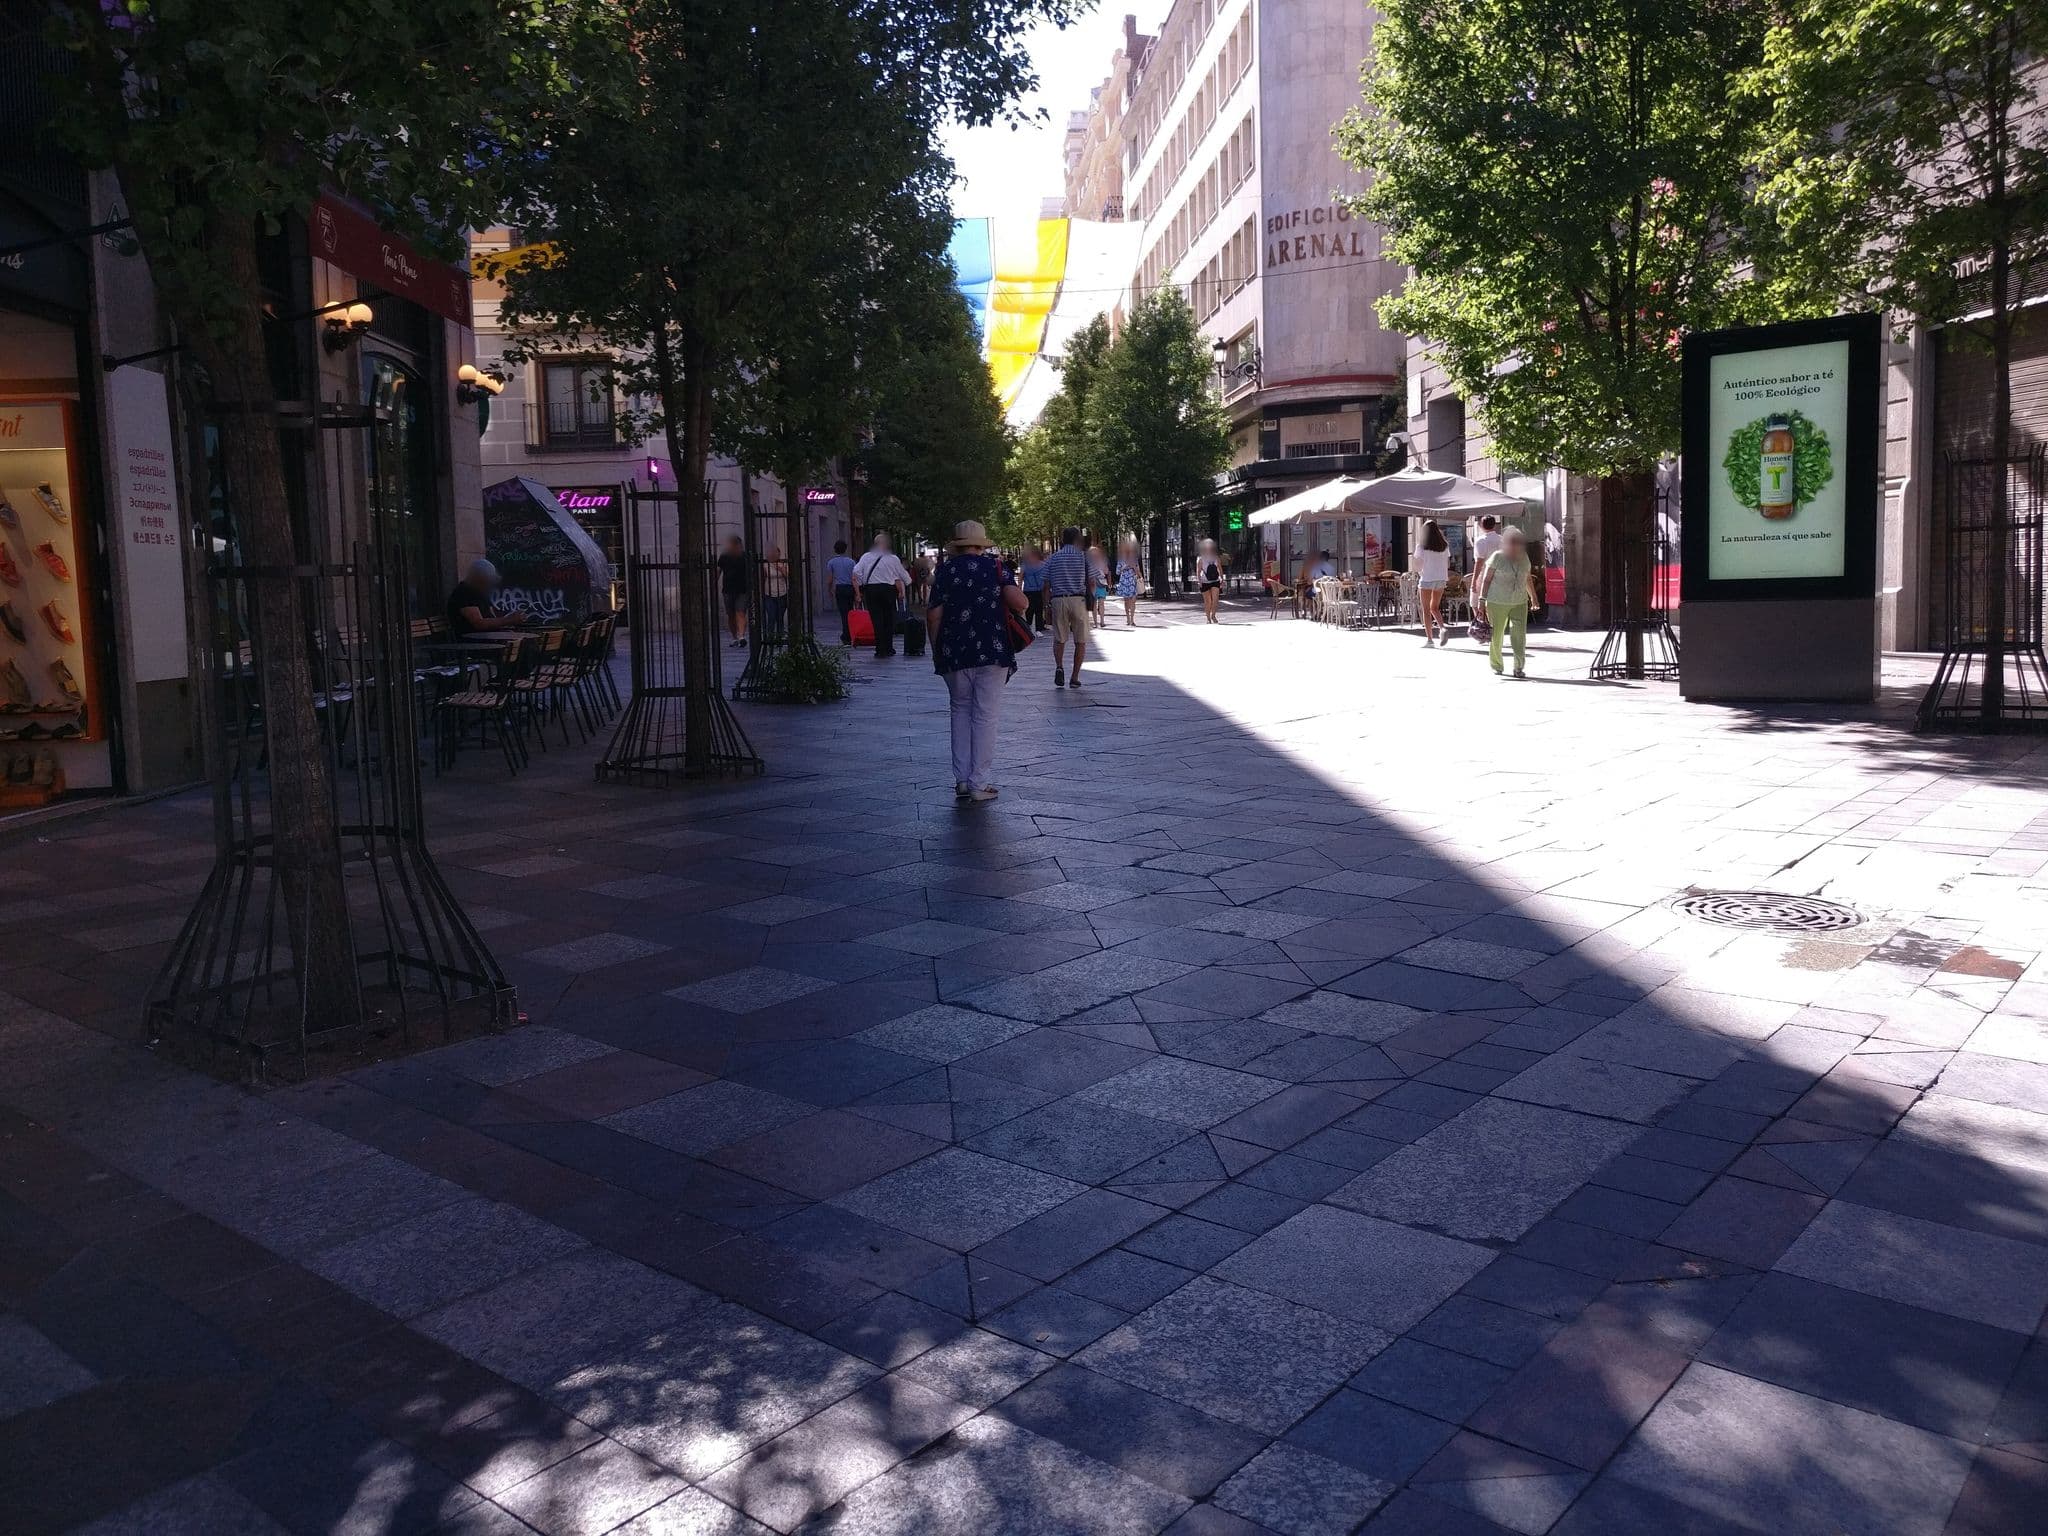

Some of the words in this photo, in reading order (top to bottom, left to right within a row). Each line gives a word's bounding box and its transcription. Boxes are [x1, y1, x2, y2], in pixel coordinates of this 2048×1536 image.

[1267, 206, 1351, 235] EDIFICIO
[1267, 232, 1364, 268] ARENAL
[1723, 376, 1778, 390] Auténtico
[1779, 372, 1812, 385] sabor
[1813, 372, 1820, 381] a
[1822, 369, 1834, 380] té
[1735, 390, 1763, 401] 100%
[1766, 385, 1821, 398] Ecológico
[0, 415, 24, 438] nt
[557, 490, 611, 508] Etam
[807, 490, 835, 500] Etam
[1721, 535, 1732, 543] La
[1733, 532, 1781, 543] naturaleza
[1782, 532, 1791, 541] sí
[1792, 533, 1809, 542] que
[1810, 530, 1832, 540] sabe
